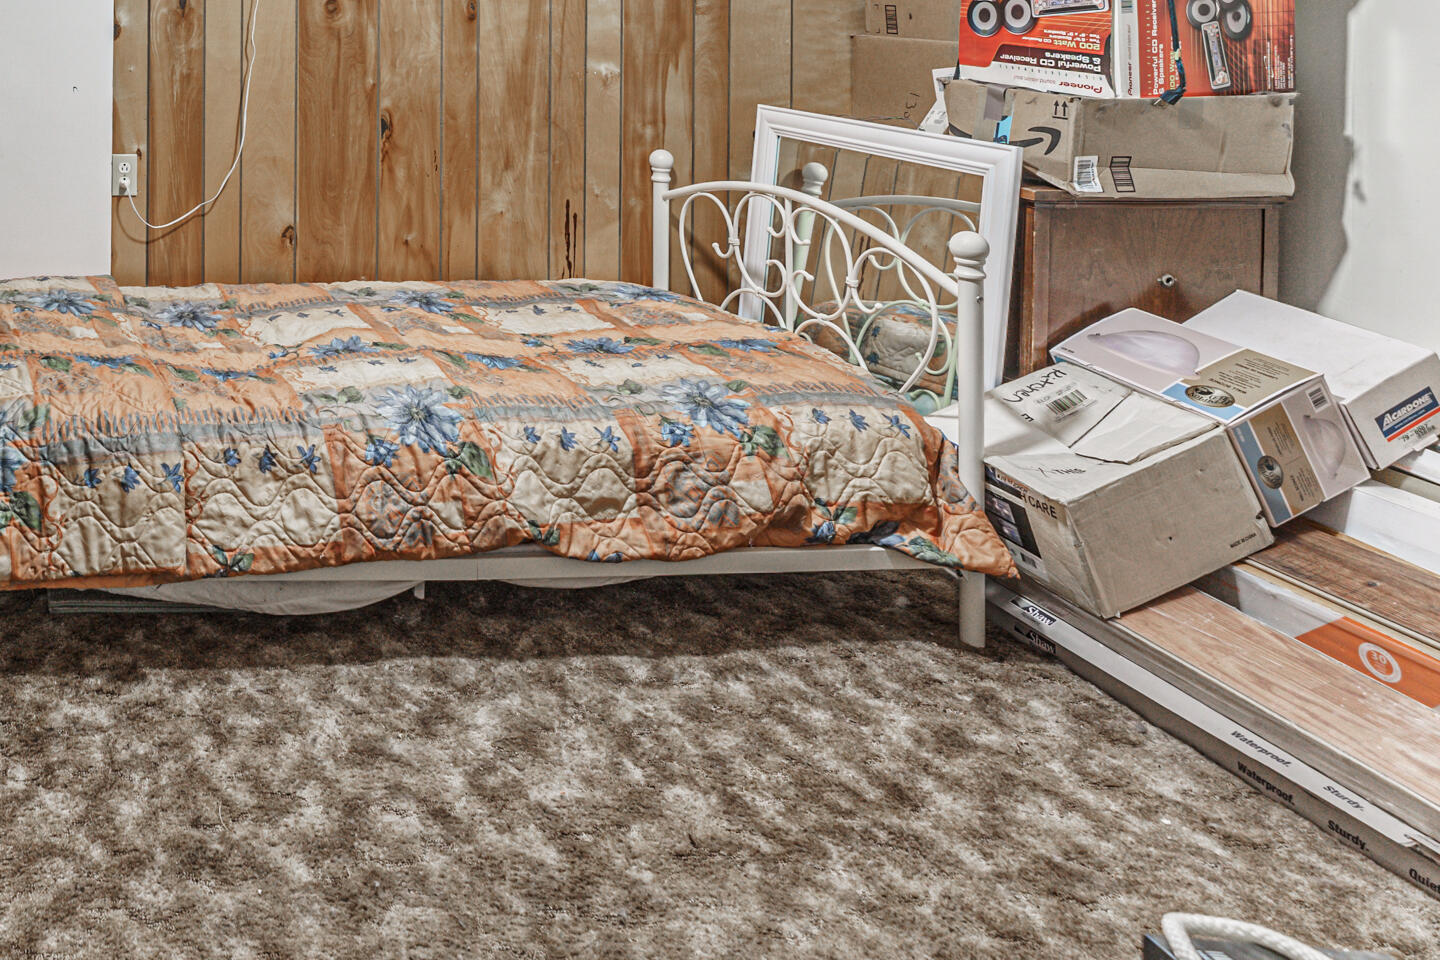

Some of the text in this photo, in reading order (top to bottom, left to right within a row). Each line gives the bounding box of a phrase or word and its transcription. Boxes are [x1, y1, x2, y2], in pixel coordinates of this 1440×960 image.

[1053, 39, 1077, 48] Watt
[1079, 42, 1101, 51] 200
[1152, 39, 1158, 54] CD
[999, 53, 1102, 72] Powerful CD Receiver
[1044, 52, 1101, 64] & Speakers
[1158, 43, 1166, 85] Speakers
[1058, 81, 1103, 95] Pioneer
[1028, 495, 1057, 519] CARE
[1026, 606, 1054, 626] Shaw
[1029, 632, 1055, 654] Shaw
[1231, 730, 1365, 812] Waterproof. Sturdy.
[1237, 761, 1295, 806] Waterproof.
[1327, 819, 1370, 853] Sturdy.
